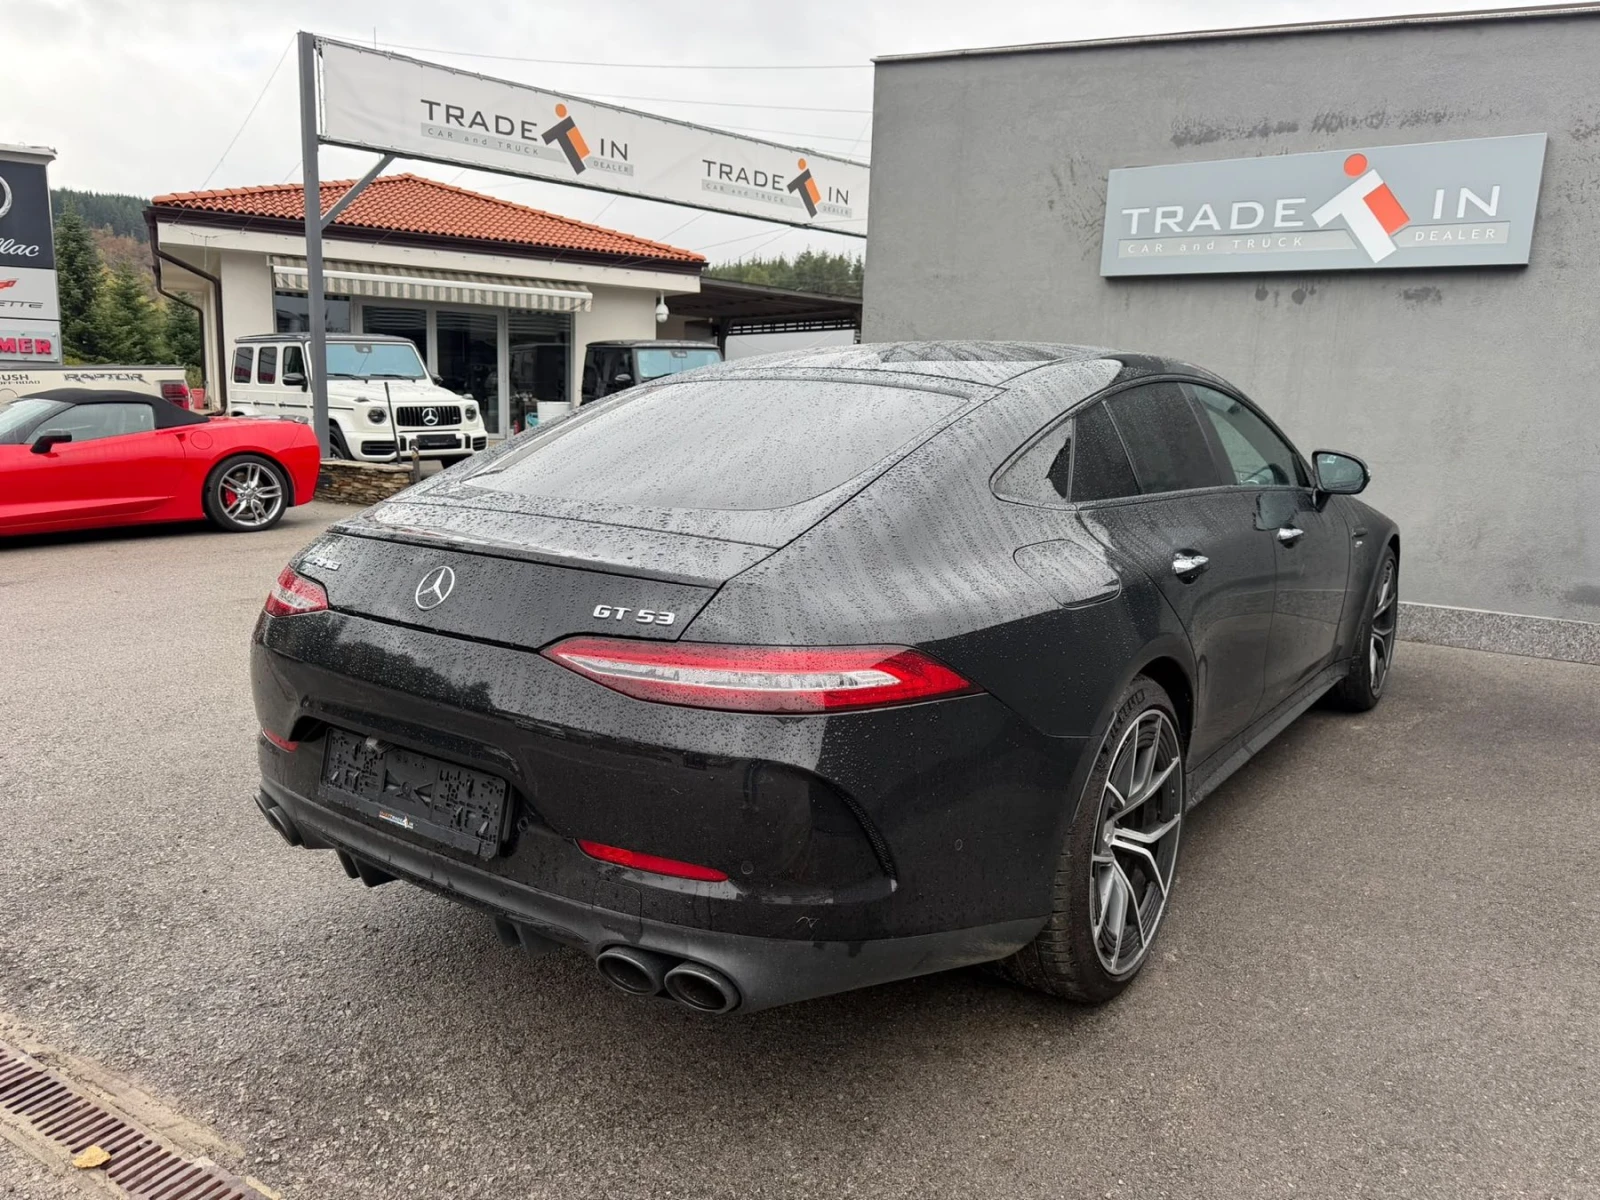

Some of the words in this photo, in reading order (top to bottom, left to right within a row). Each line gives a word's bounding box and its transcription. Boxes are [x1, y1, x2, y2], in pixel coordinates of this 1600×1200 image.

[420, 99, 538, 142] TRADE
[600, 138, 628, 161] IN
[427, 127, 453, 139] CAR
[464, 135, 487, 146] and
[498, 141, 539, 156] TRUCK
[593, 160, 629, 173] DEALER
[702, 159, 784, 192] TRADE
[828, 186, 849, 206] IN
[1121, 198, 1306, 235] TRADE
[1432, 185, 1500, 220] IN
[1127, 243, 1163, 254] CAR
[1179, 241, 1215, 251] and
[1232, 236, 1302, 249] TRUCK
[1415, 228, 1495, 242] DEALER
[0, 337, 52, 355] MER
[593, 604, 632, 621] GT
[636, 609, 675, 625] 53
